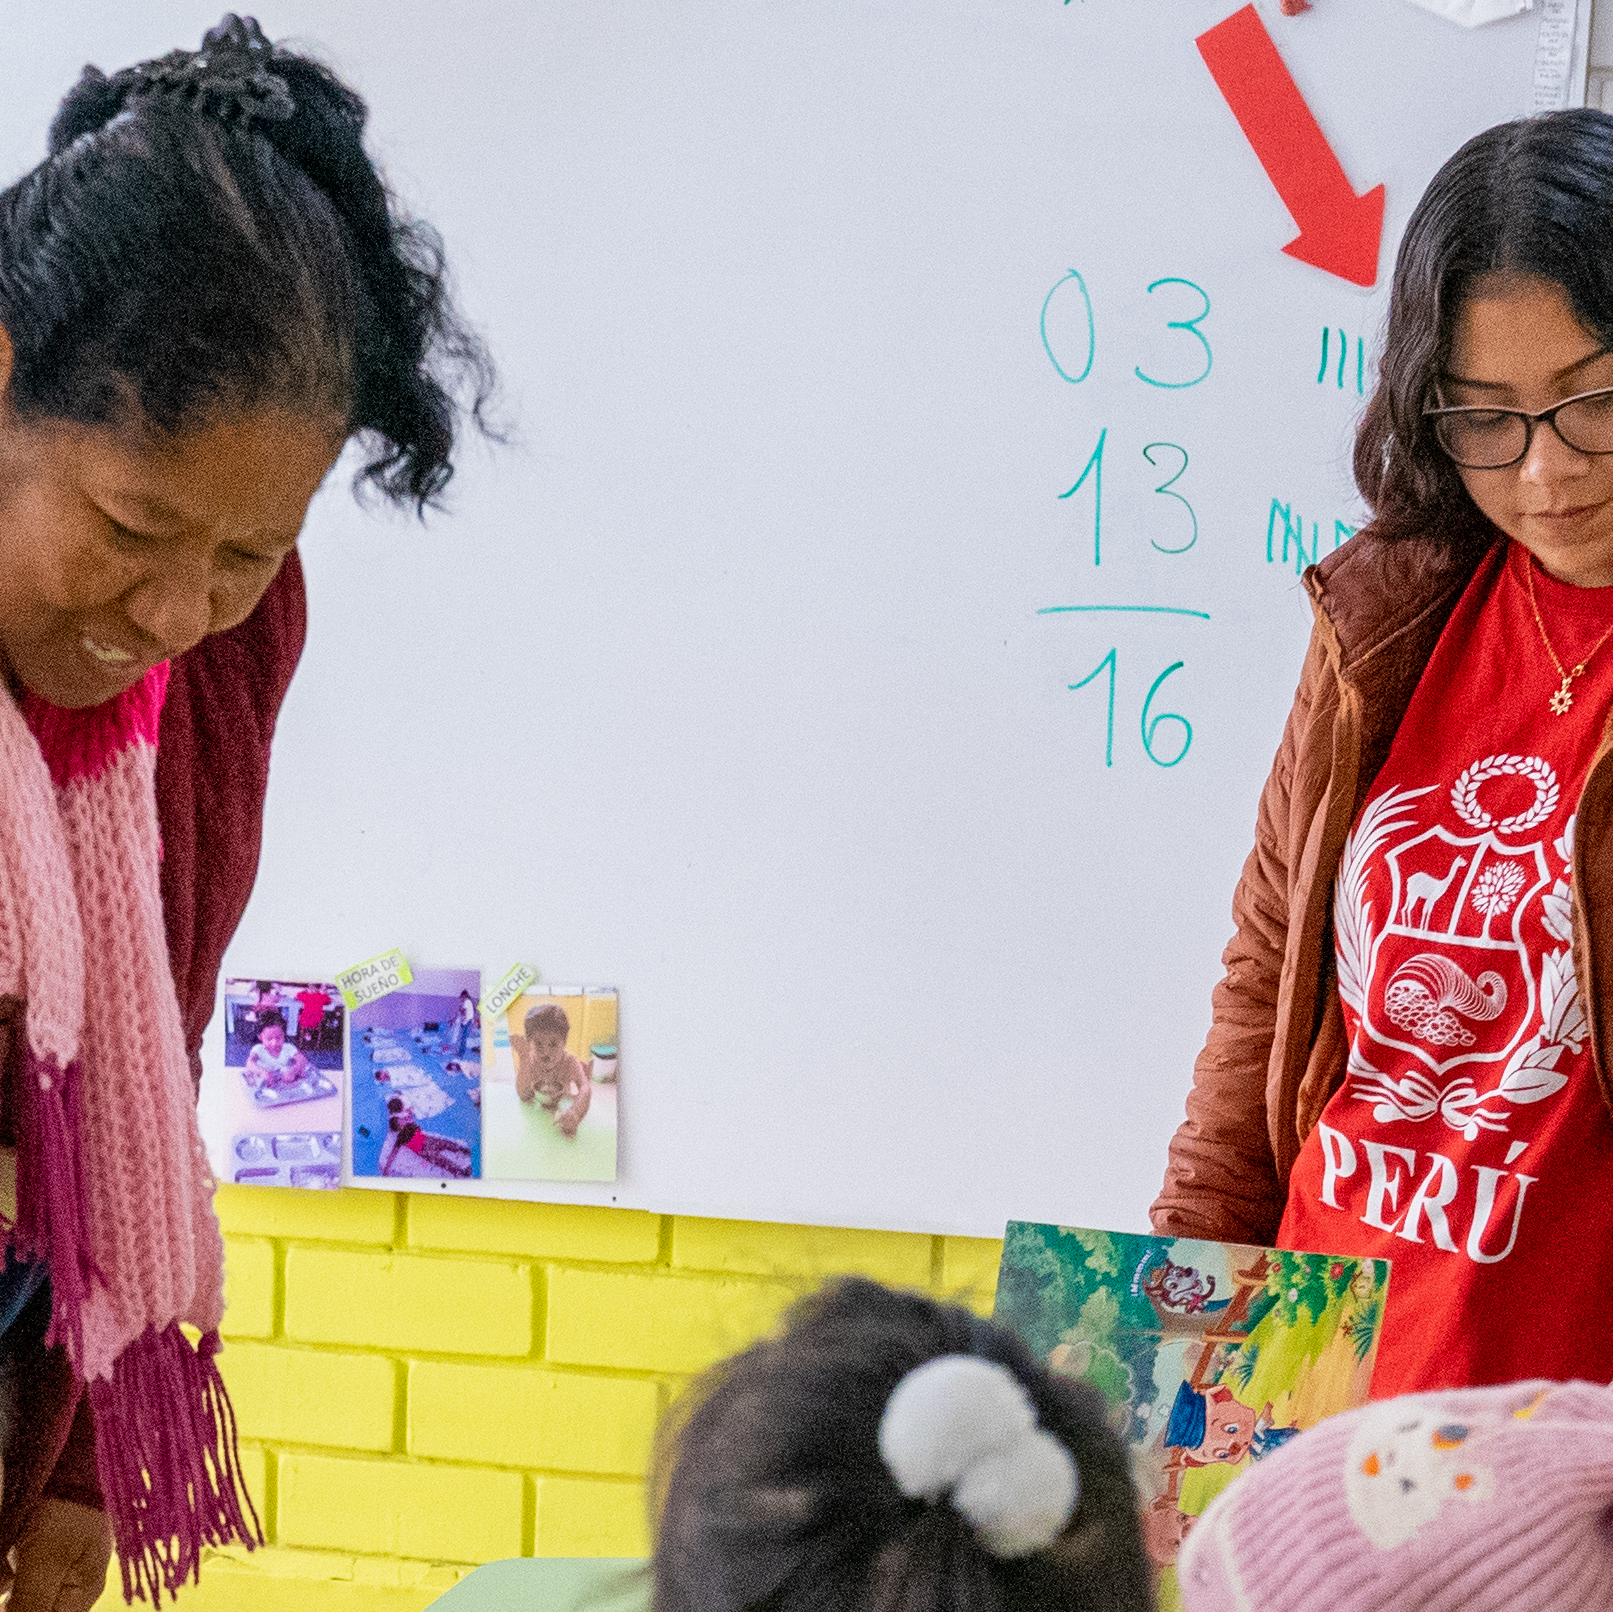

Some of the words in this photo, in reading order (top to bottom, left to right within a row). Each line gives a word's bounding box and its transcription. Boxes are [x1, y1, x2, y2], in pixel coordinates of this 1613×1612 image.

[1067, 647, 1194, 768] 16
[342, 964, 383, 992] HORA
[380, 956, 401, 973] DE
[354, 972, 400, 1003] SUEÑO
[485, 966, 531, 1015] LONCHE
[1317, 1121, 1538, 1265] PERÚ
